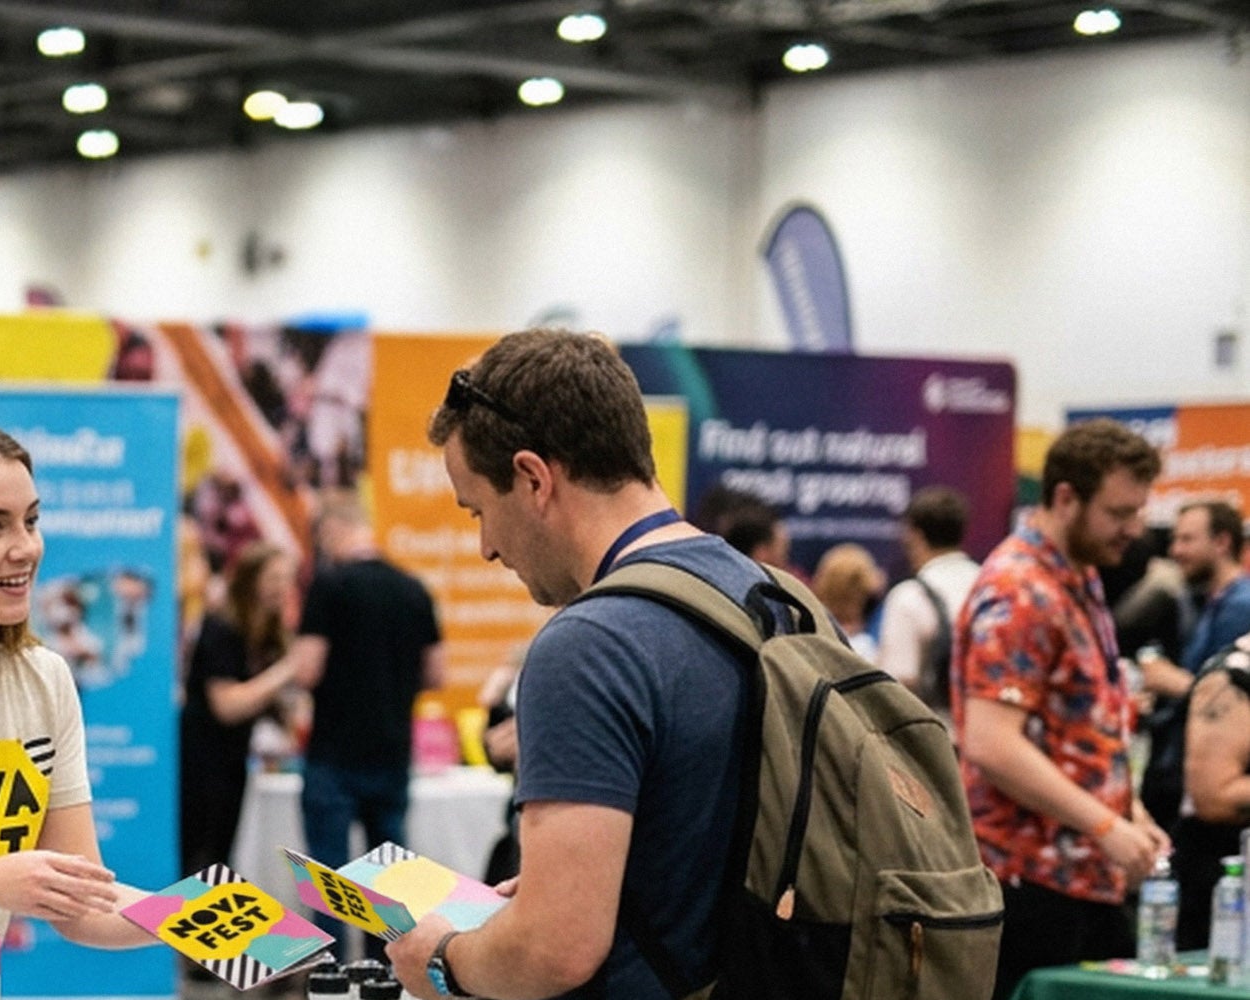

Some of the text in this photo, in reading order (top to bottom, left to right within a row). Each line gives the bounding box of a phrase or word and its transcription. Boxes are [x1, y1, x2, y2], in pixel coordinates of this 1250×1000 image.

[167, 893, 258, 939] NOVA
[317, 871, 349, 917] NOVA
[337, 880, 371, 923] FEST
[195, 905, 269, 950] FEST
